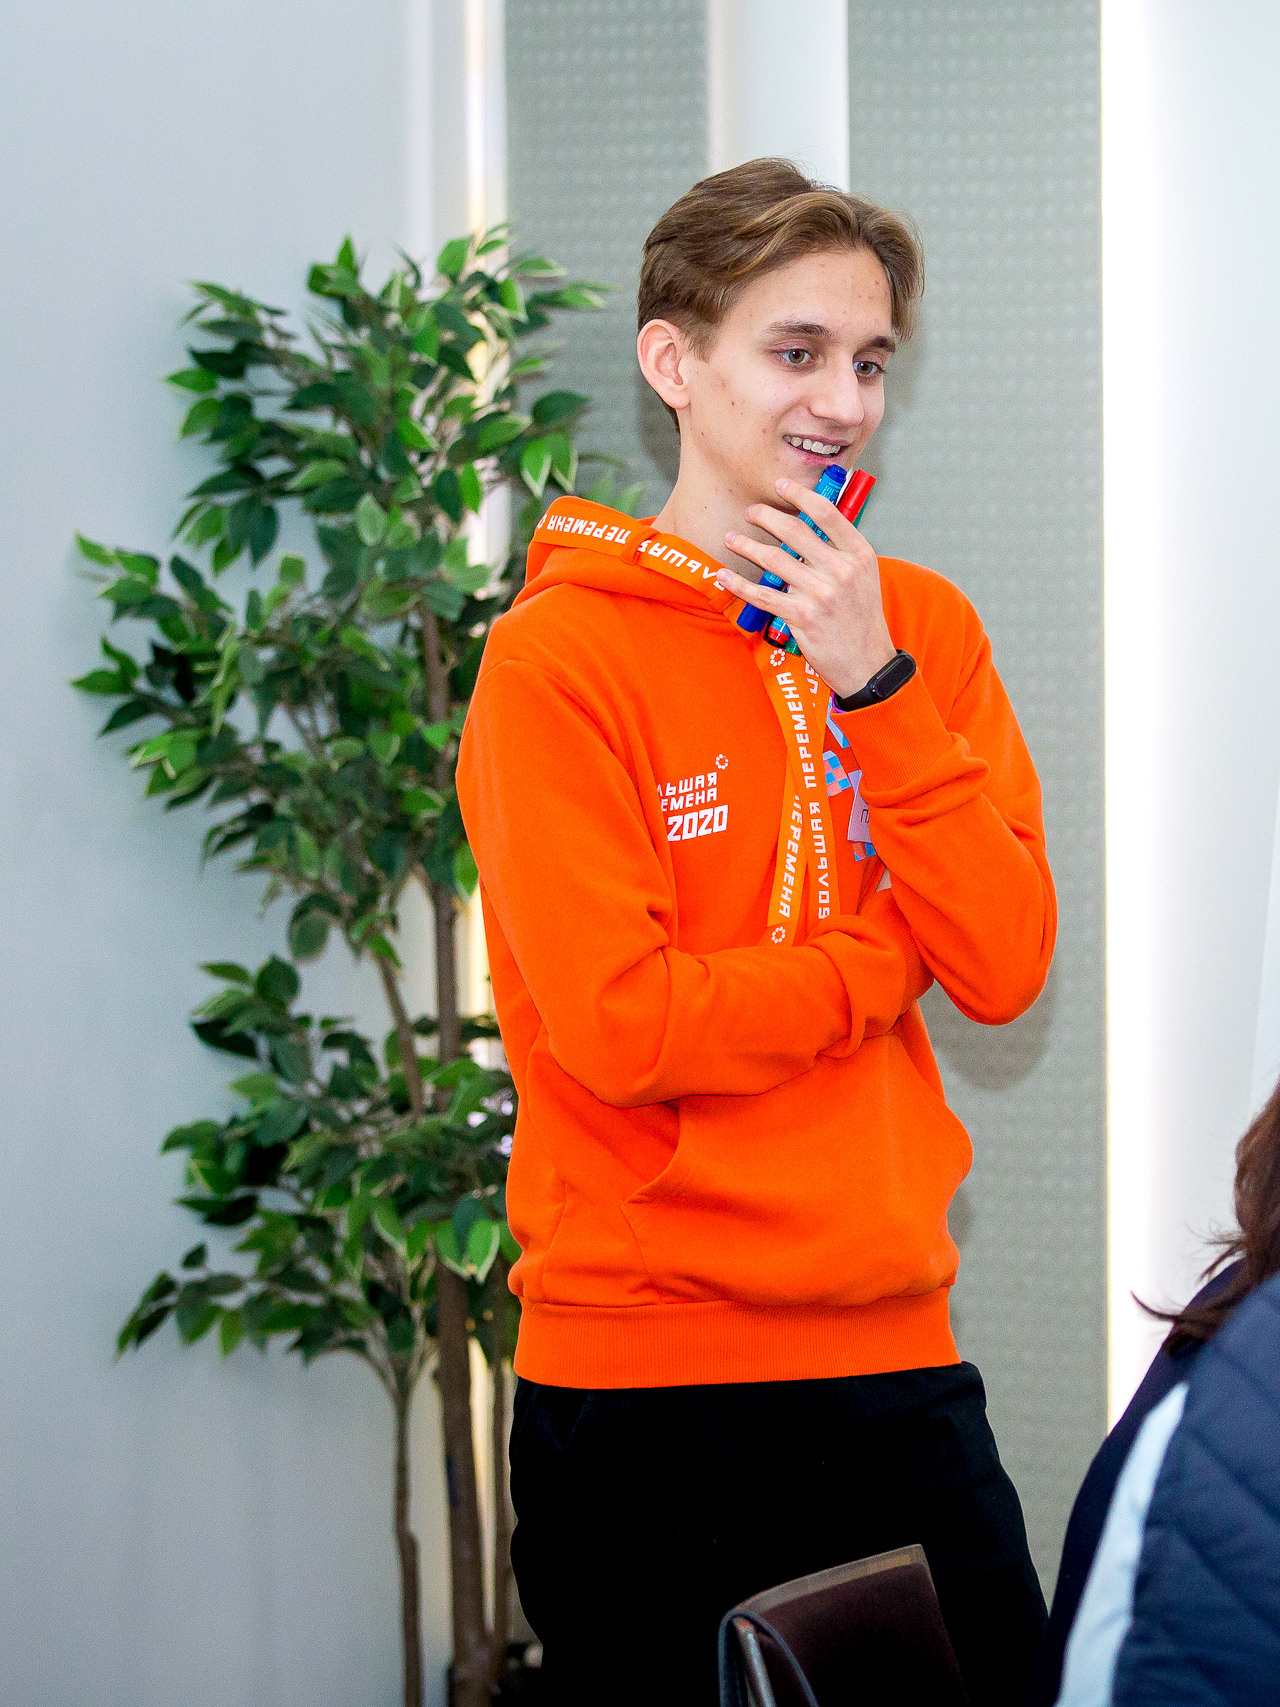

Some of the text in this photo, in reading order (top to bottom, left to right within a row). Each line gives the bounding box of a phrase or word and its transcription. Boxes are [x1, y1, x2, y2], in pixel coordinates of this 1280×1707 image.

[547, 514, 632, 545] ПЕРЕМЕНА
[776, 671, 817, 789] ПЕРЕМЕНА
[657, 772, 717, 797] ЛЬШАЯ
[661, 787, 717, 812] ЕМЕНА
[667, 804, 729, 842] 2020
[809, 801, 830, 919] БОЛЬШАЯ
